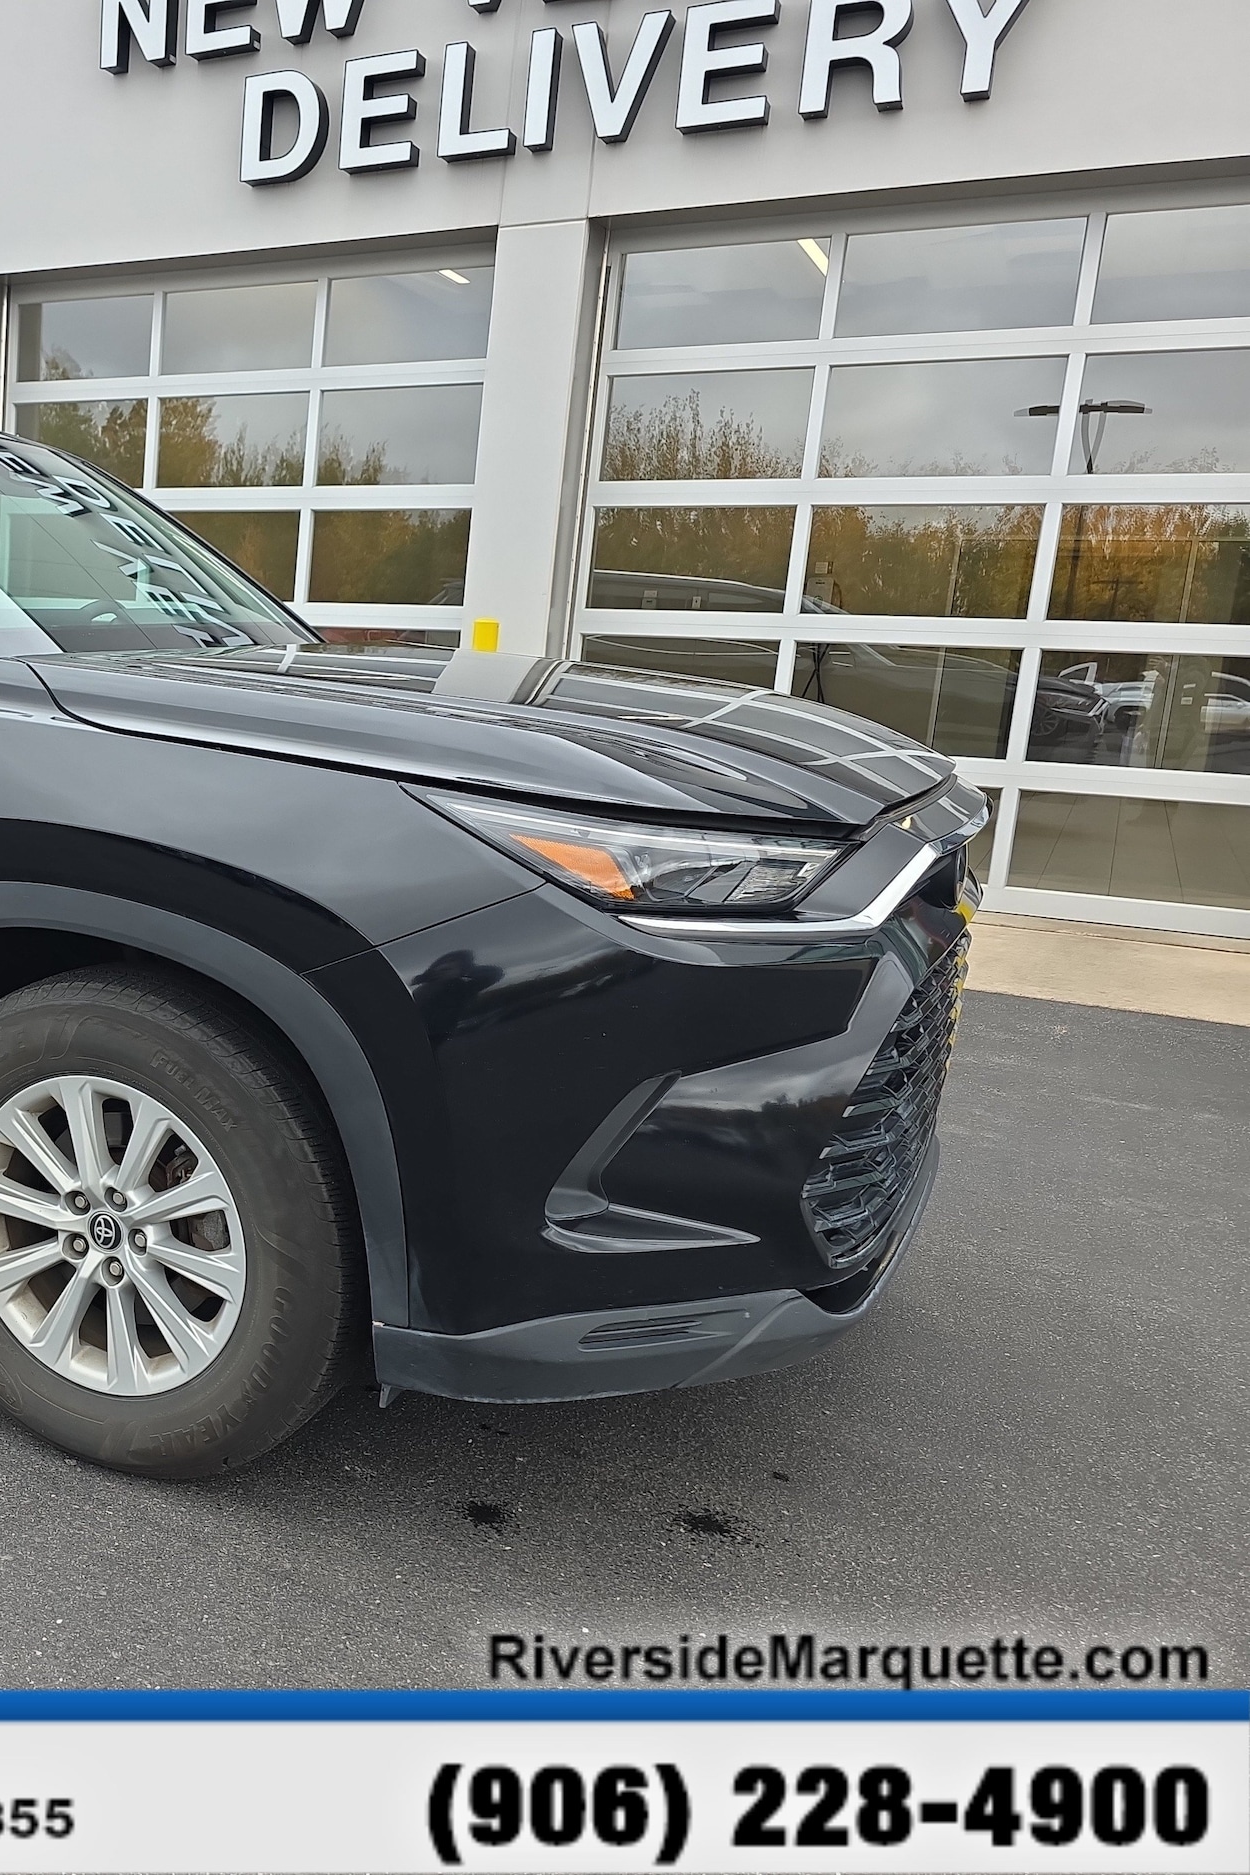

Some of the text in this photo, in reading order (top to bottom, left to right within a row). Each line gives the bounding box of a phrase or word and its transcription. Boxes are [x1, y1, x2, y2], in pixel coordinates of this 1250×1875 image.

[239, 0, 1028, 187] DELIVERY
[150, 1048, 238, 1132] FUEL MAX
